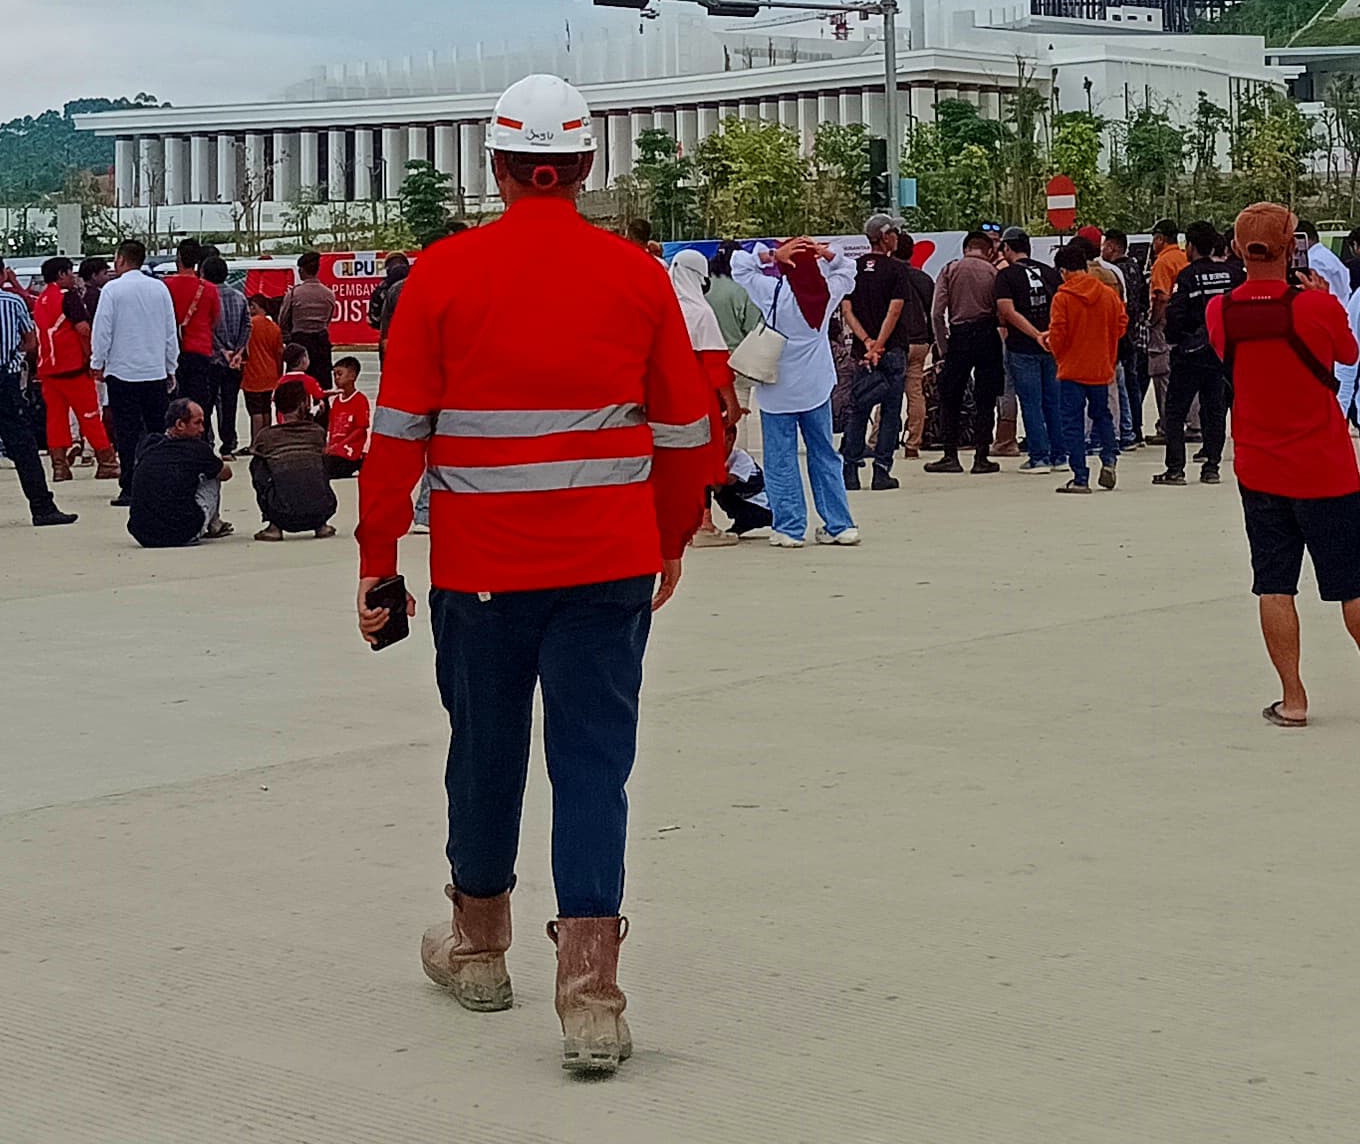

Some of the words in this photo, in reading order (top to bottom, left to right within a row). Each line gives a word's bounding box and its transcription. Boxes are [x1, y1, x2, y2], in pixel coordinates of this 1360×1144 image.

[354, 260, 385, 276] PUP
[332, 283, 378, 297] PEMBAN
[330, 299, 371, 322] DIST
